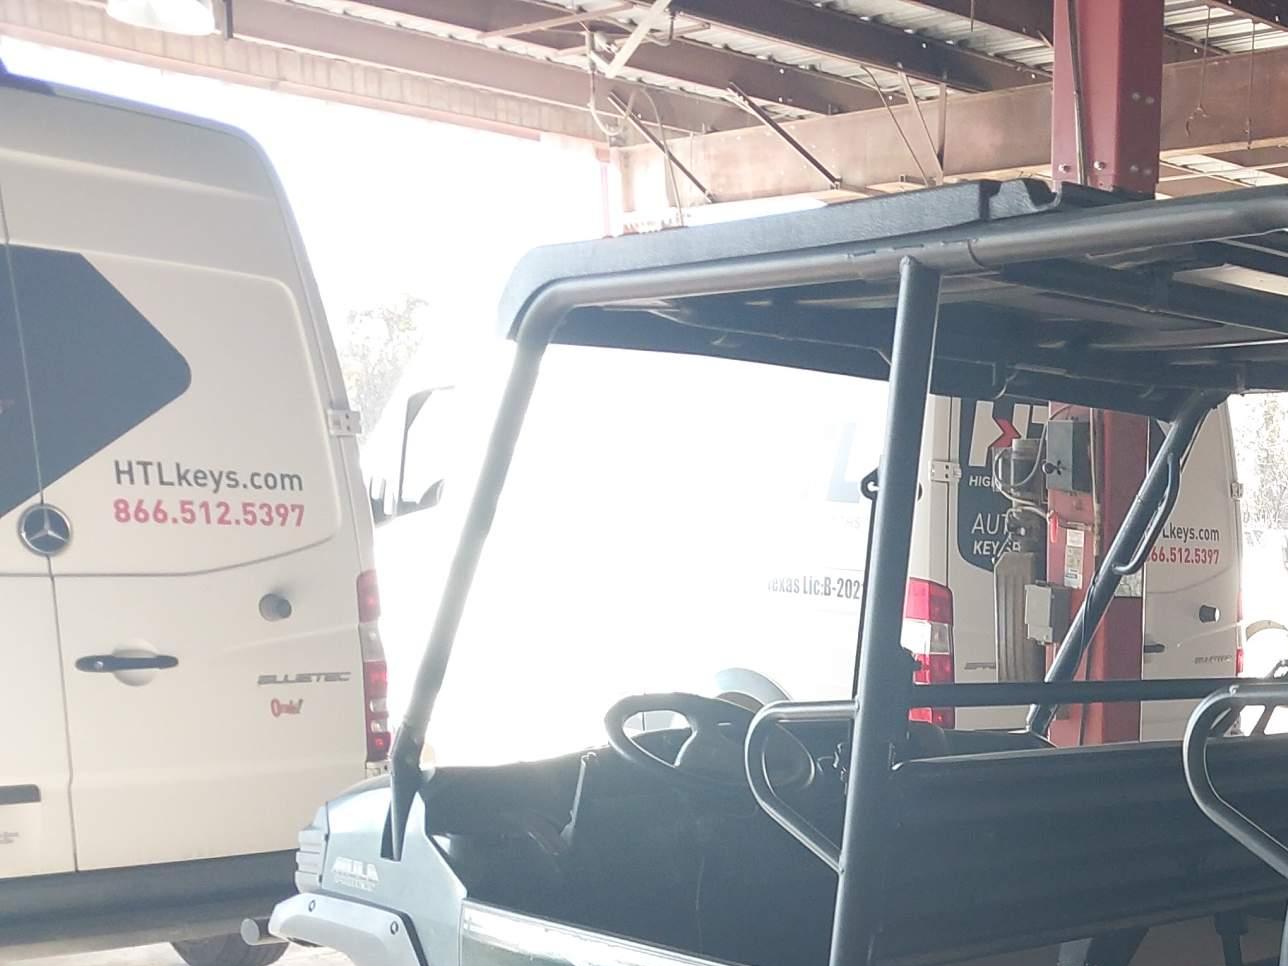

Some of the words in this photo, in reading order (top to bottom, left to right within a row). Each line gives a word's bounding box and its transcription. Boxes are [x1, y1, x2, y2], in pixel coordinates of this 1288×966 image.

[113, 459, 304, 494] HTLkeys.com
[969, 475, 1001, 488] HIG
[112, 498, 305, 527] 866.512.5397
[971, 512, 1009, 536] AUT
[1162, 522, 1220, 543] Lkeys.com
[973, 540, 1000, 555] KEY
[1148, 546, 1220, 565] 66.512.5397
